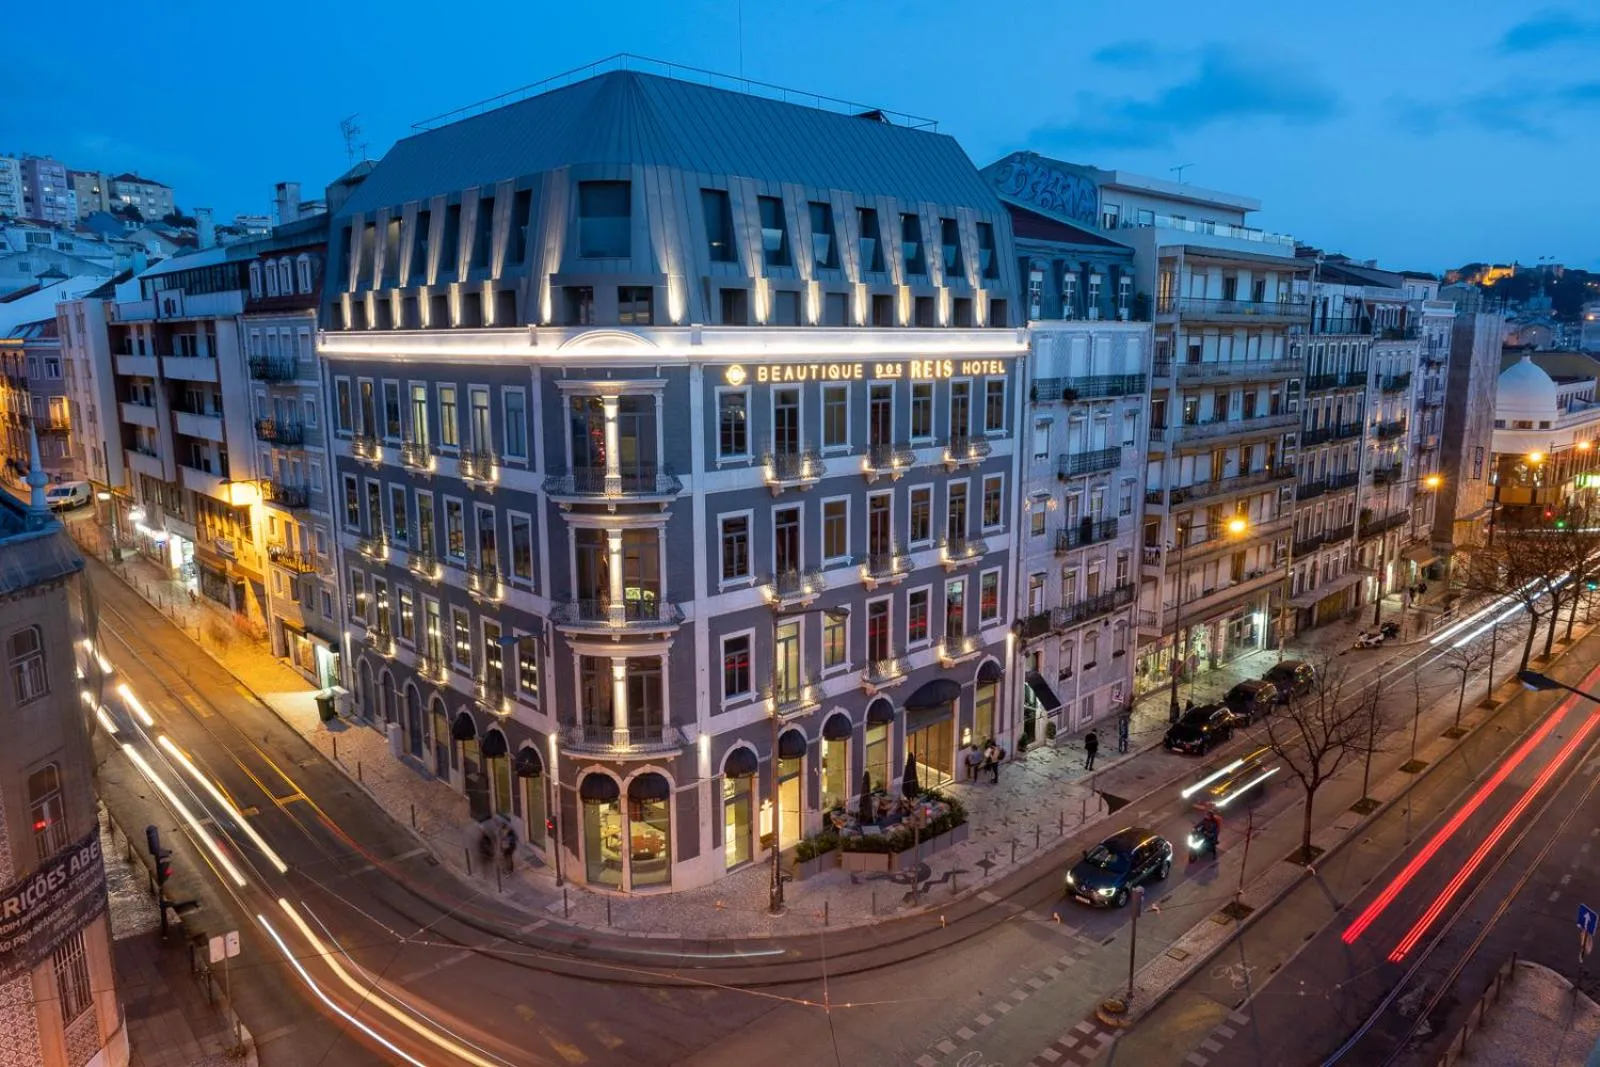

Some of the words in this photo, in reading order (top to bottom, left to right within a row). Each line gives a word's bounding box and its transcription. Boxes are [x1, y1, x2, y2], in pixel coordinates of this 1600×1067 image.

[757, 363, 864, 382] BEAUTIQUE
[910, 359, 954, 380] REIS
[962, 360, 1007, 376] HOTEL
[0, 864, 67, 923] RIÇÕES
